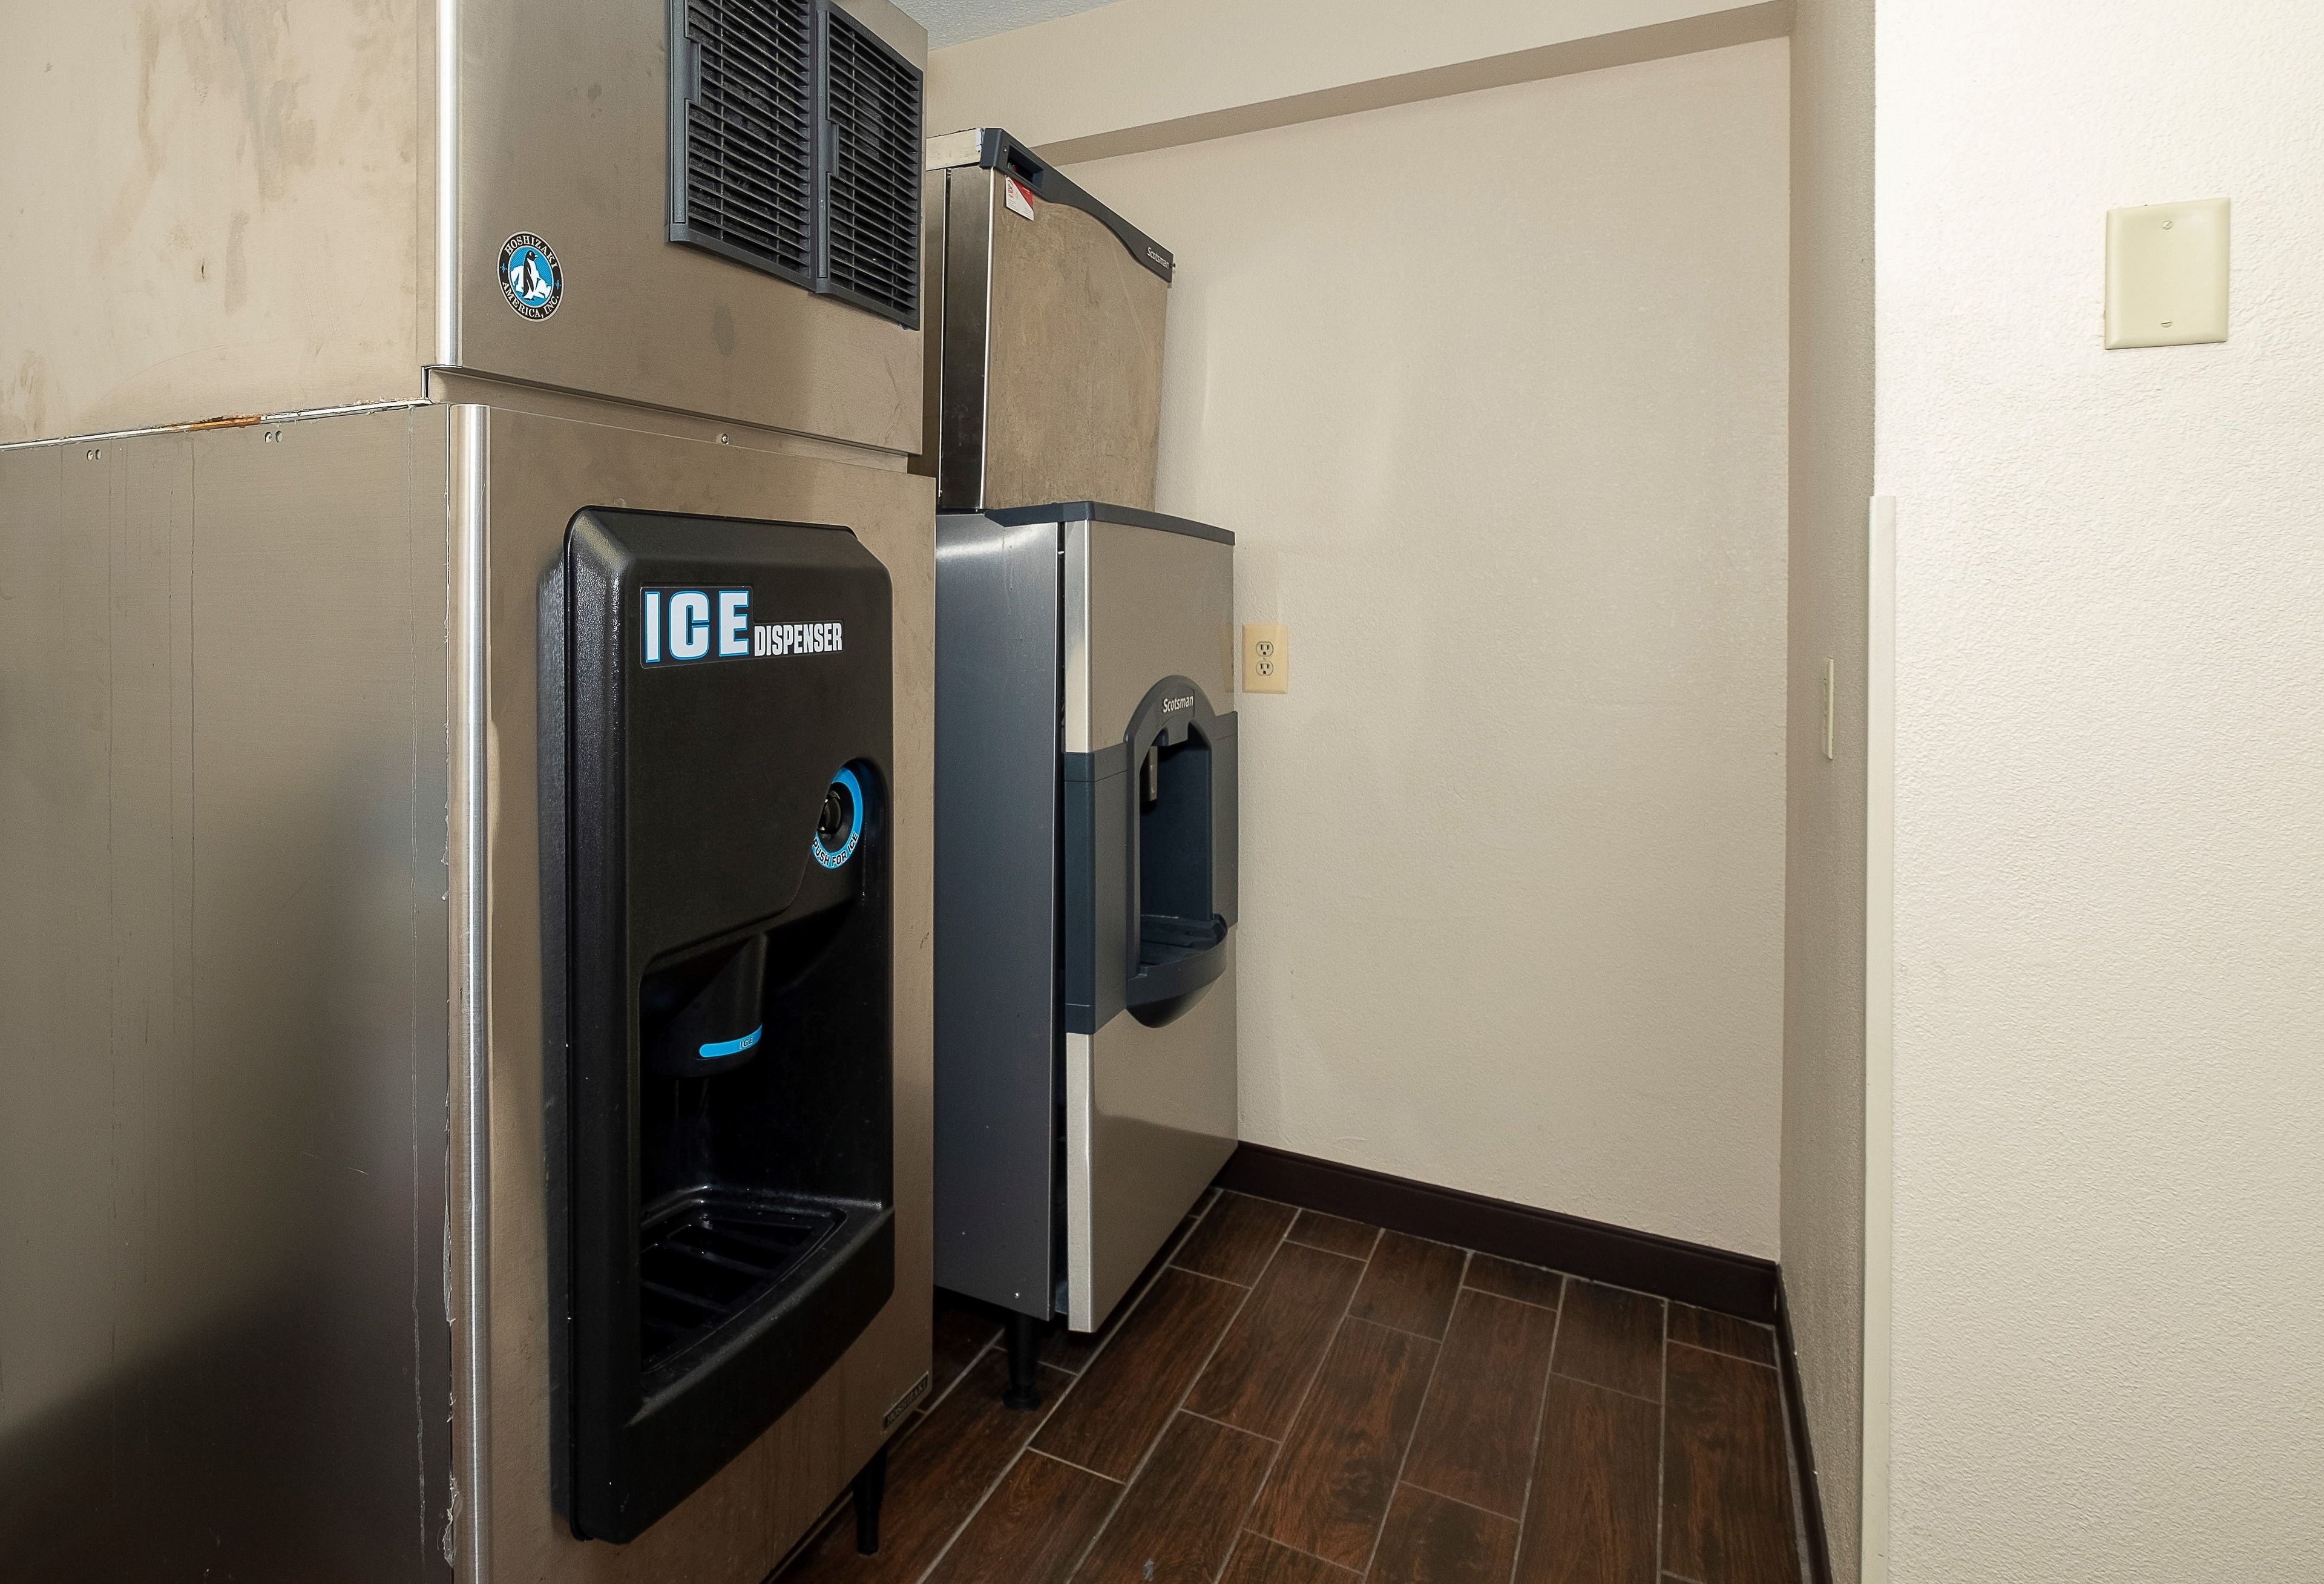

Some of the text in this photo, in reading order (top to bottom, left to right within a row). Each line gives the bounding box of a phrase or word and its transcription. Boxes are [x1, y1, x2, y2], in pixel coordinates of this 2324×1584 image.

[504, 235, 558, 269] HOSHIZAKI
[502, 281, 559, 318] AMERICA, INC.
[645, 590, 842, 663] ICE DISPENSER
[1163, 696, 1193, 713] Scotsman
[812, 832, 859, 867] PUSH FOR ICE
[739, 1036, 753, 1049] ICE
